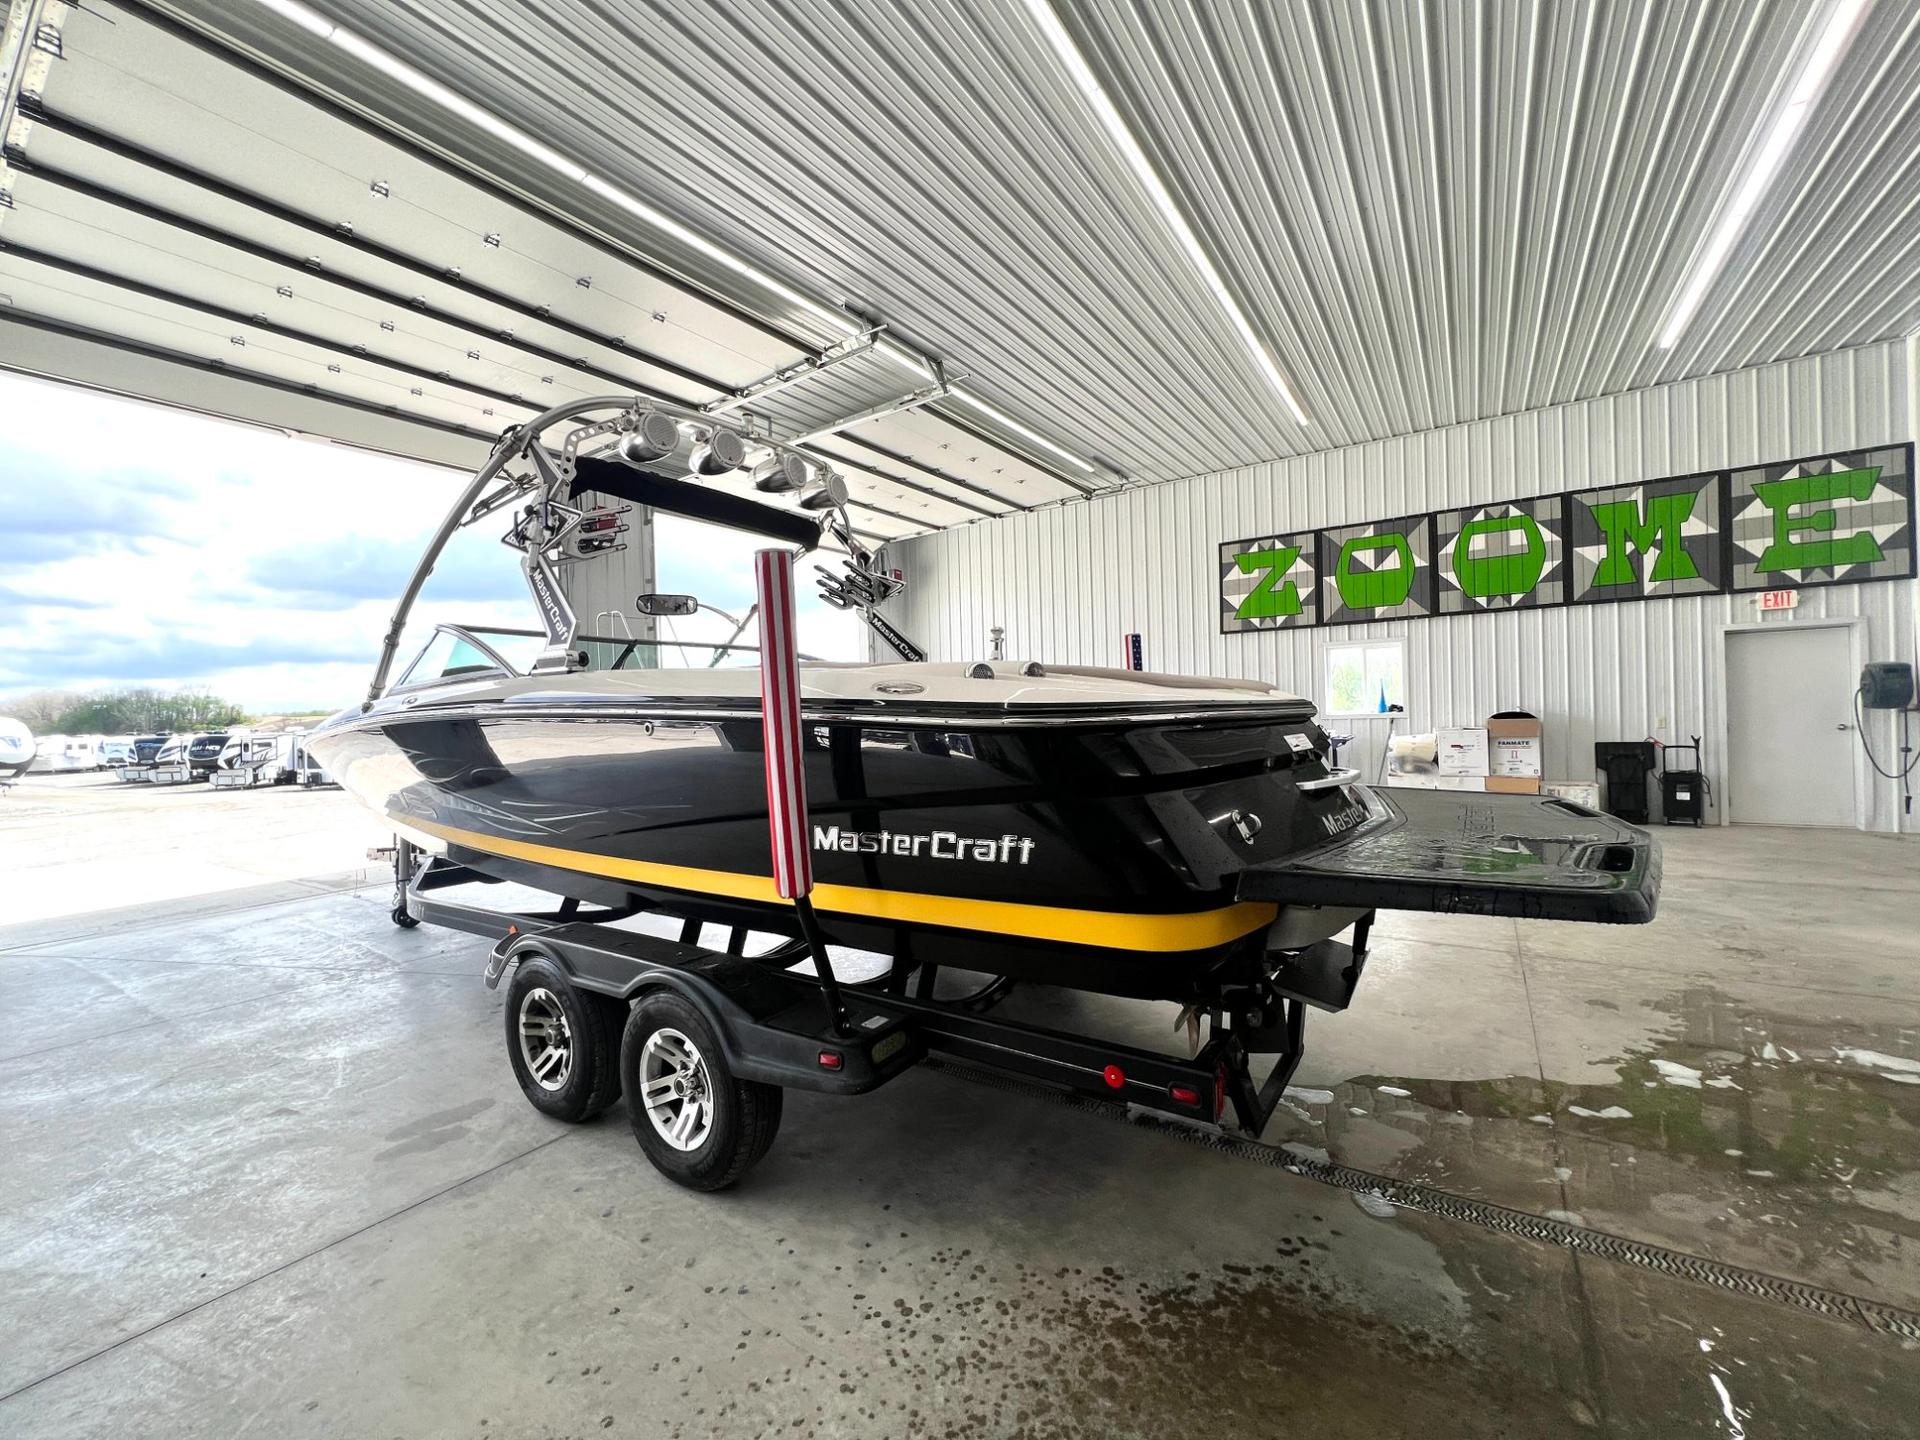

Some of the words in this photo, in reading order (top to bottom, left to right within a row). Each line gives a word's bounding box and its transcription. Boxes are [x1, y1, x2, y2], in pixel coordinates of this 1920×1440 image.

[532, 568, 569, 640] MasterCraft
[1763, 590, 1792, 608] EXIT
[872, 617, 921, 662] MasterCraf
[813, 824, 1035, 864] MasterCraft
